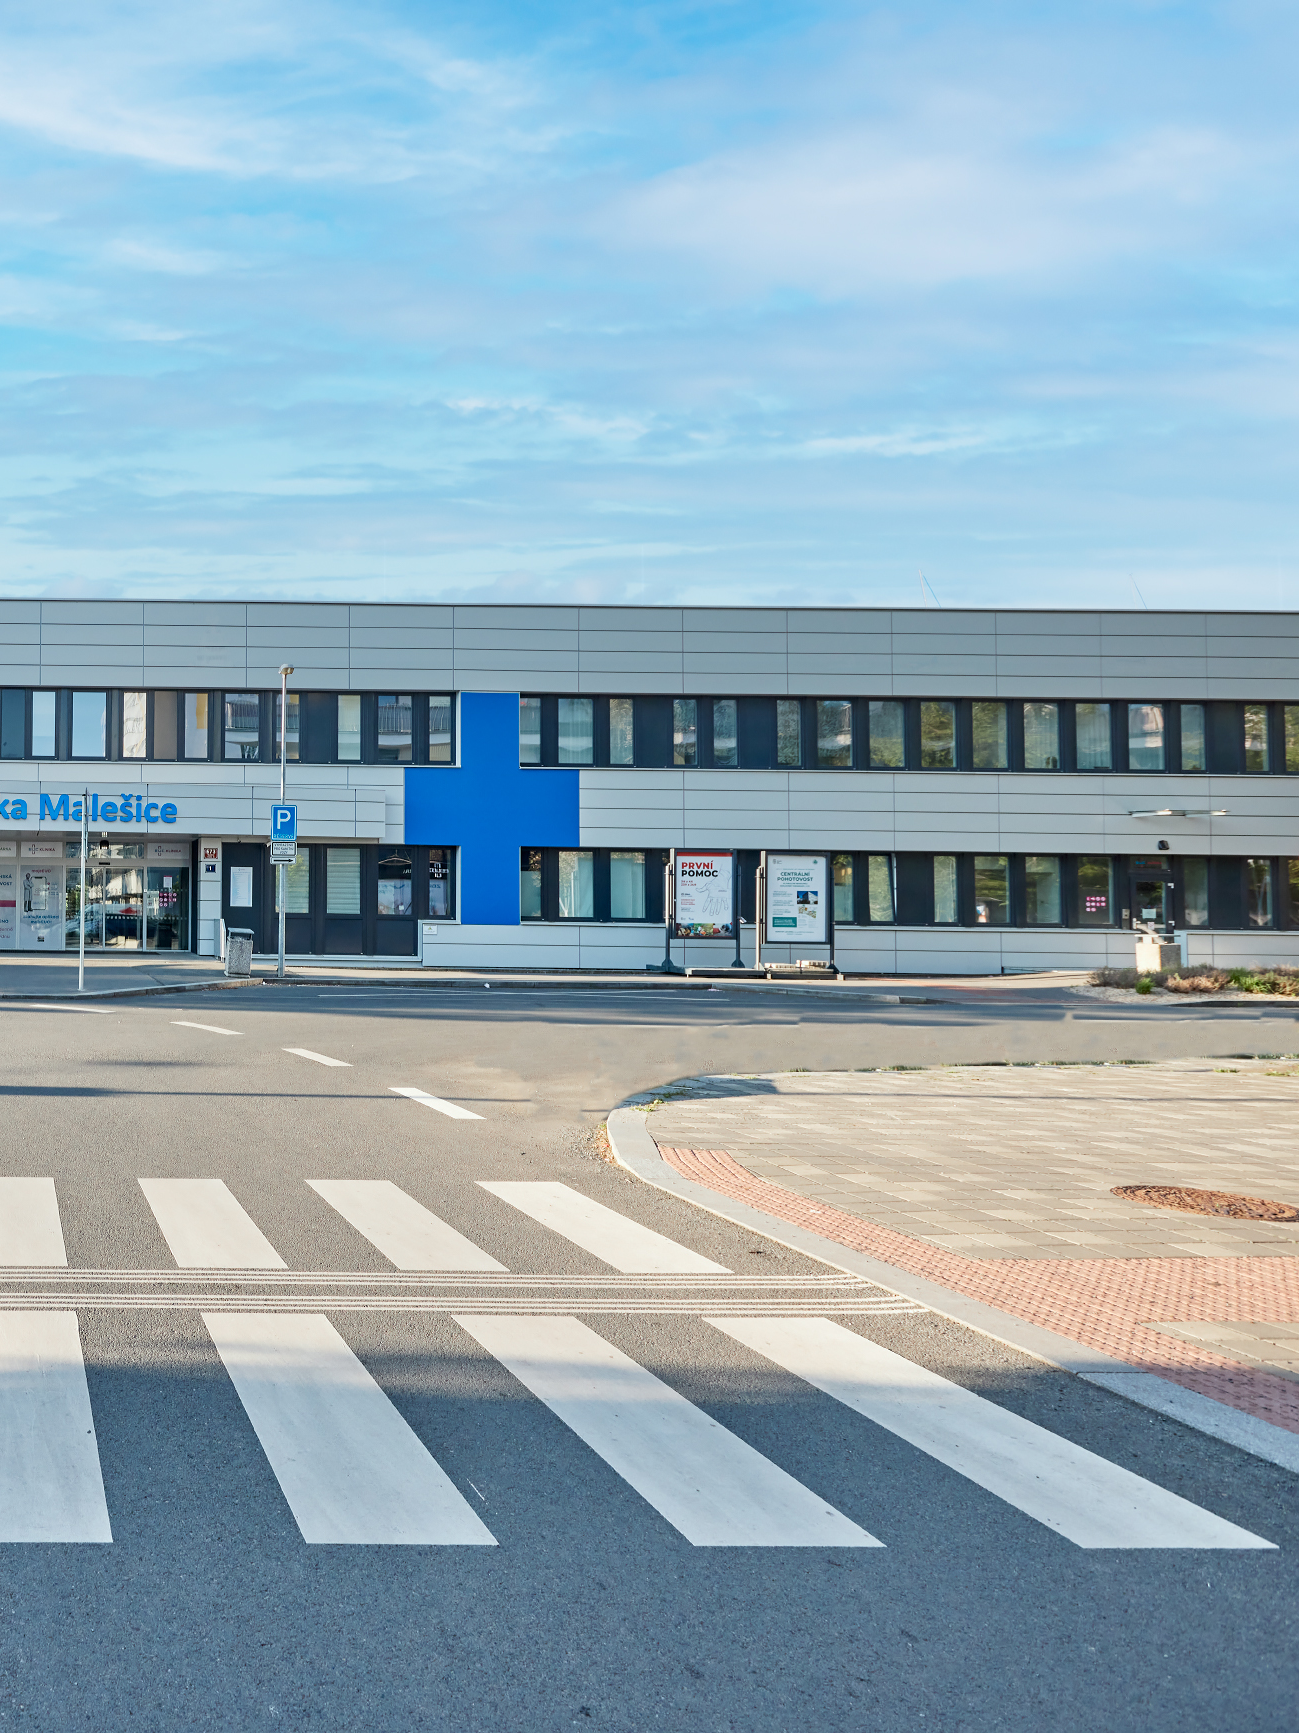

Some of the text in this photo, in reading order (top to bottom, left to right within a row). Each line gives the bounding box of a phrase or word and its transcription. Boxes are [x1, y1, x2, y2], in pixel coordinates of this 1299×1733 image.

[39, 793, 178, 823] Malešice
[277, 810, 291, 829] P
[681, 860, 714, 870] PRVNÍ
[681, 869, 719, 878] POMOC
